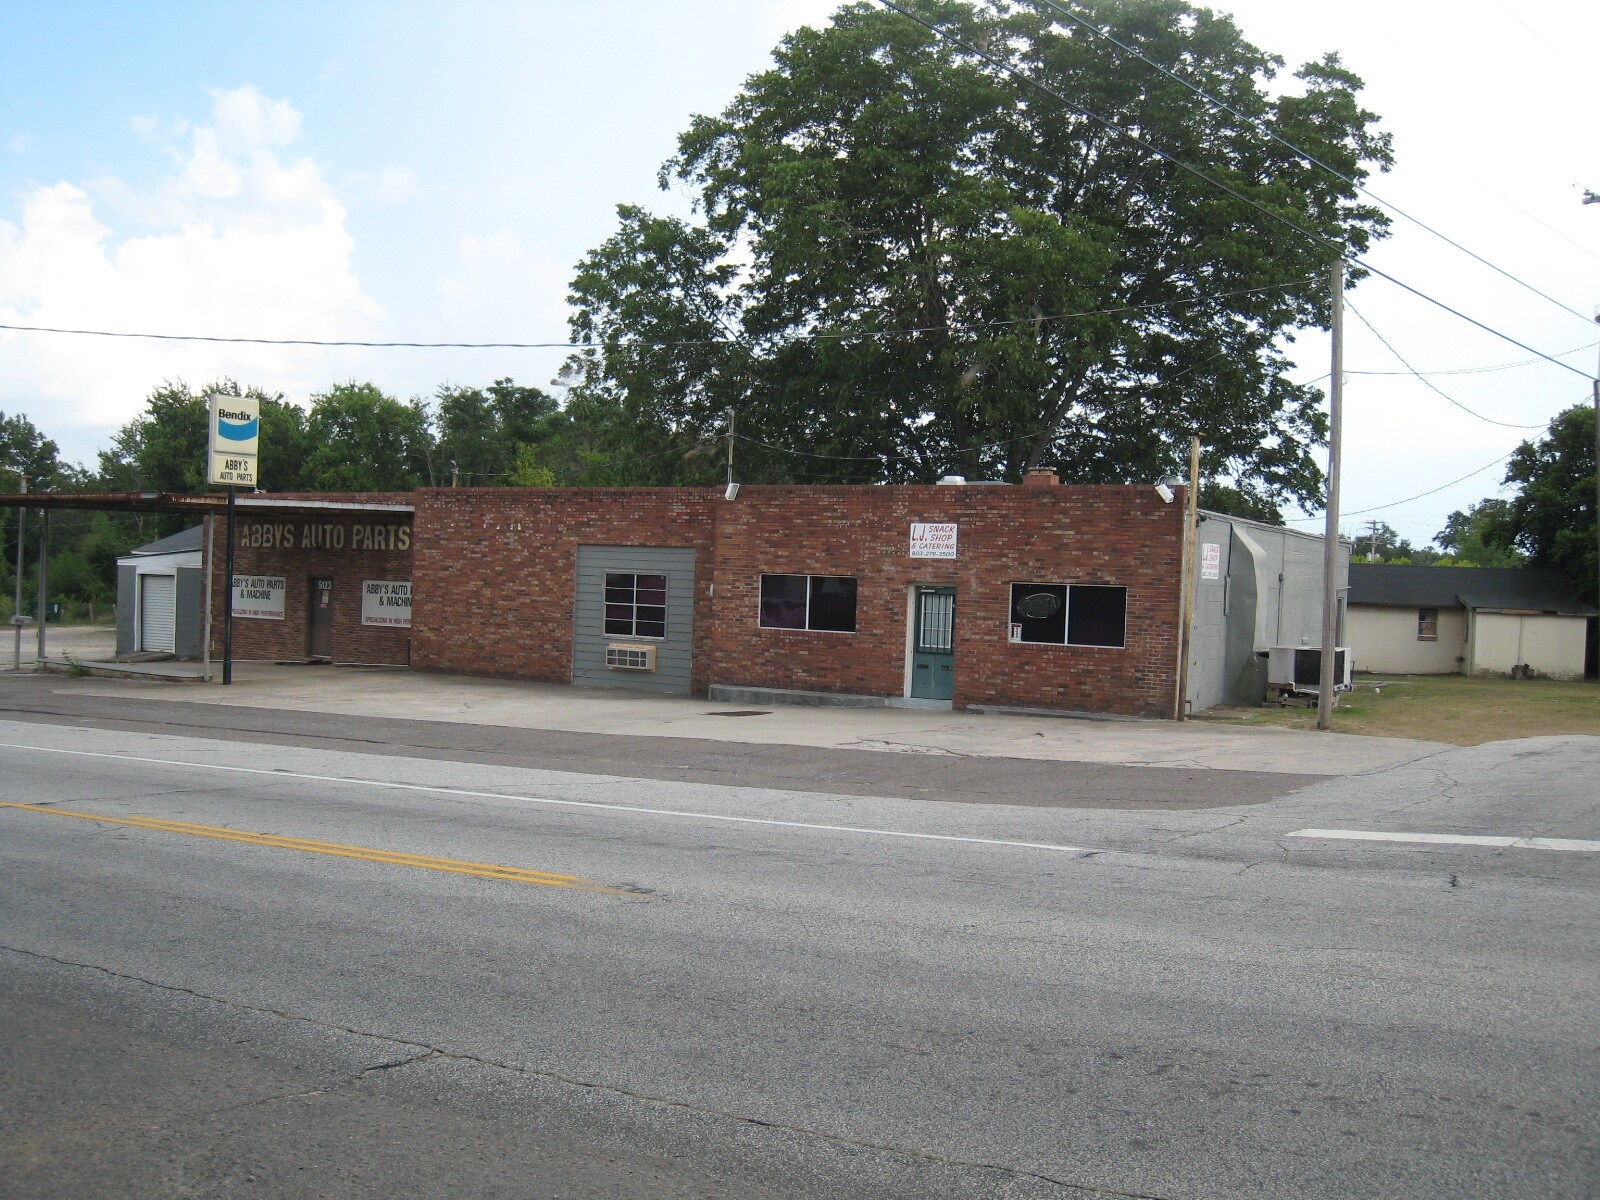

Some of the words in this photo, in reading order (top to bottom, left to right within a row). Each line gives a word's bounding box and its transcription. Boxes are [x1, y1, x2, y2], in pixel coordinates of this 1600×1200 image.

[218, 408, 252, 421] Bendix
[224, 459, 249, 472] ABBY'S
[219, 471, 234, 481] AUTO
[236, 472, 253, 482] PARTS
[929, 525, 955, 533] SNACK
[241, 523, 295, 548] ABBYS
[301, 524, 344, 549] AUTO
[352, 524, 410, 550] PARTS
[232, 578, 249, 588] BBY'S
[250, 579, 265, 589] AUTO
[266, 580, 285, 590] PARTS
[318, 580, 332, 590] 5123
[366, 584, 389, 595] ABBY'S
[390, 585, 408, 596] AUTO
[240, 589, 245, 599] &
[246, 590, 271, 600] MACHINE
[379, 595, 384, 606] &
[386, 596, 412, 607] MACHIN
